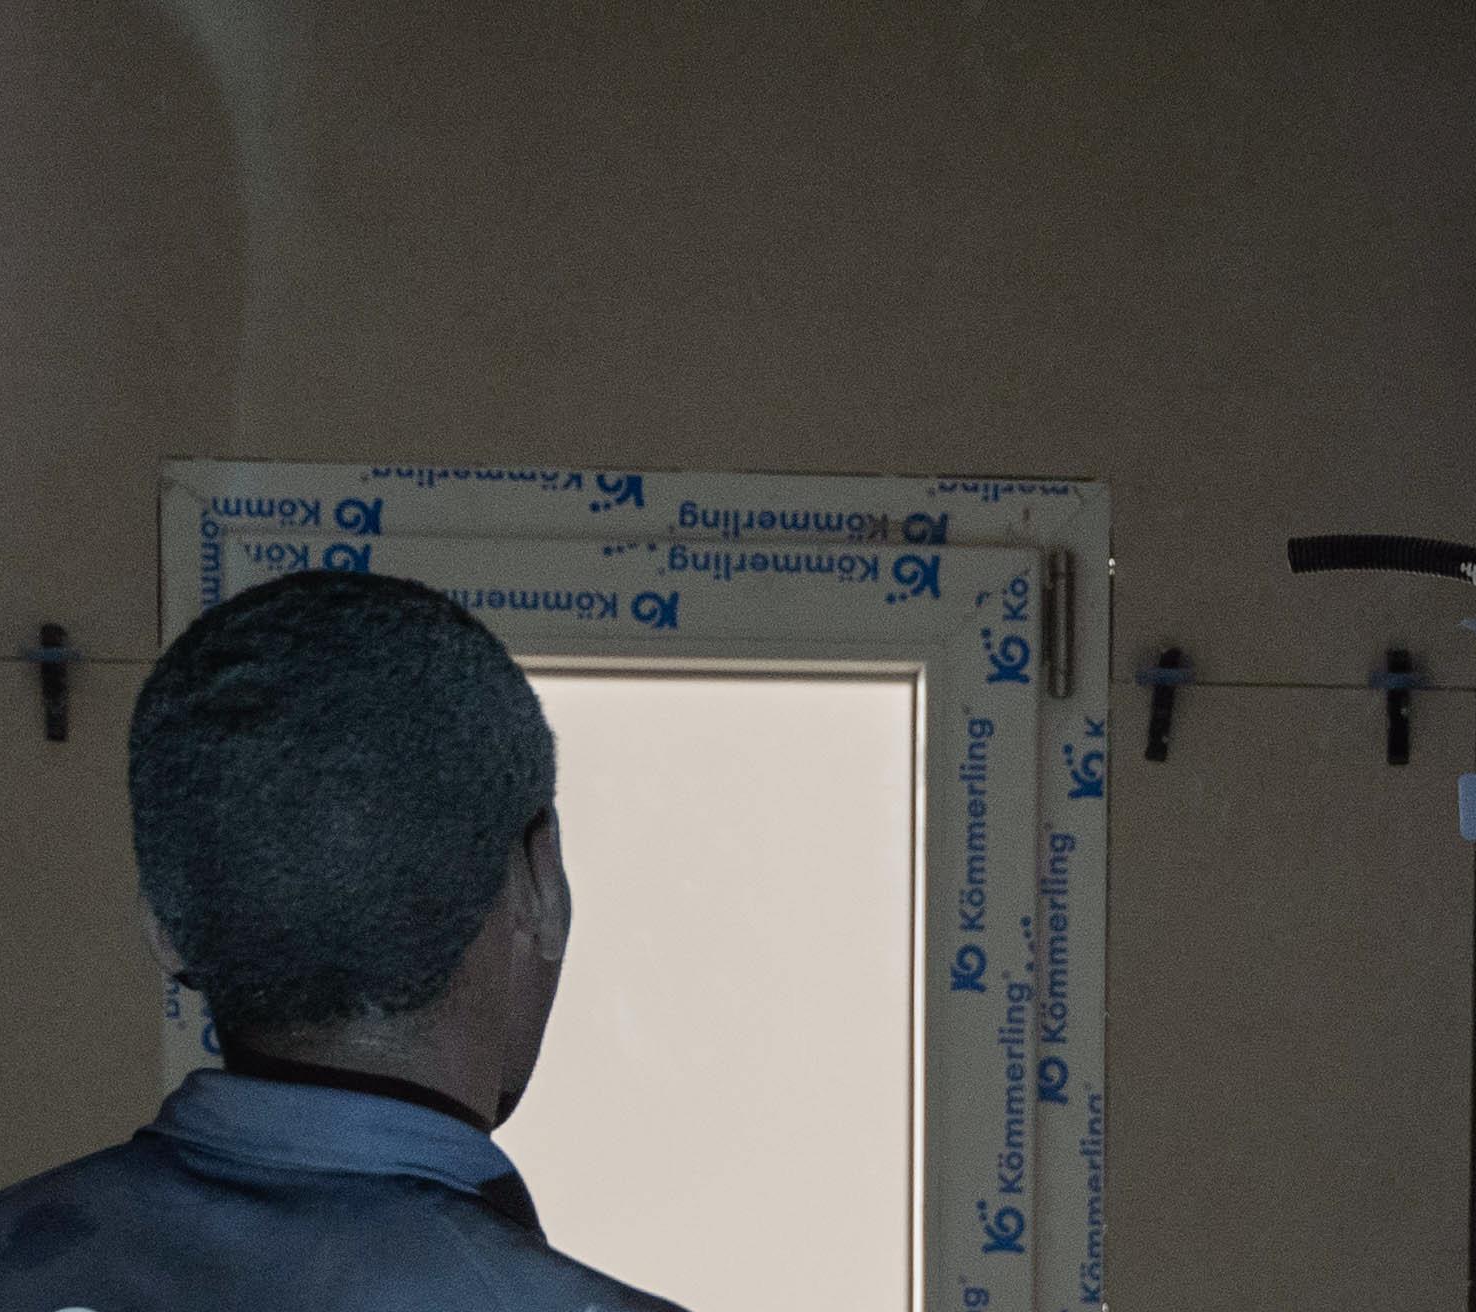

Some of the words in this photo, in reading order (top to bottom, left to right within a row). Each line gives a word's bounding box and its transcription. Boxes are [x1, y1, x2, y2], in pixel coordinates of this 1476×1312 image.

[668, 544, 880, 583] Kömmerling
[676, 502, 889, 542] Kömmerling
[958, 716, 995, 933] Kömmerling
[1041, 832, 1074, 1044] Kömmerling
[998, 981, 1032, 1195] Kömmerling
